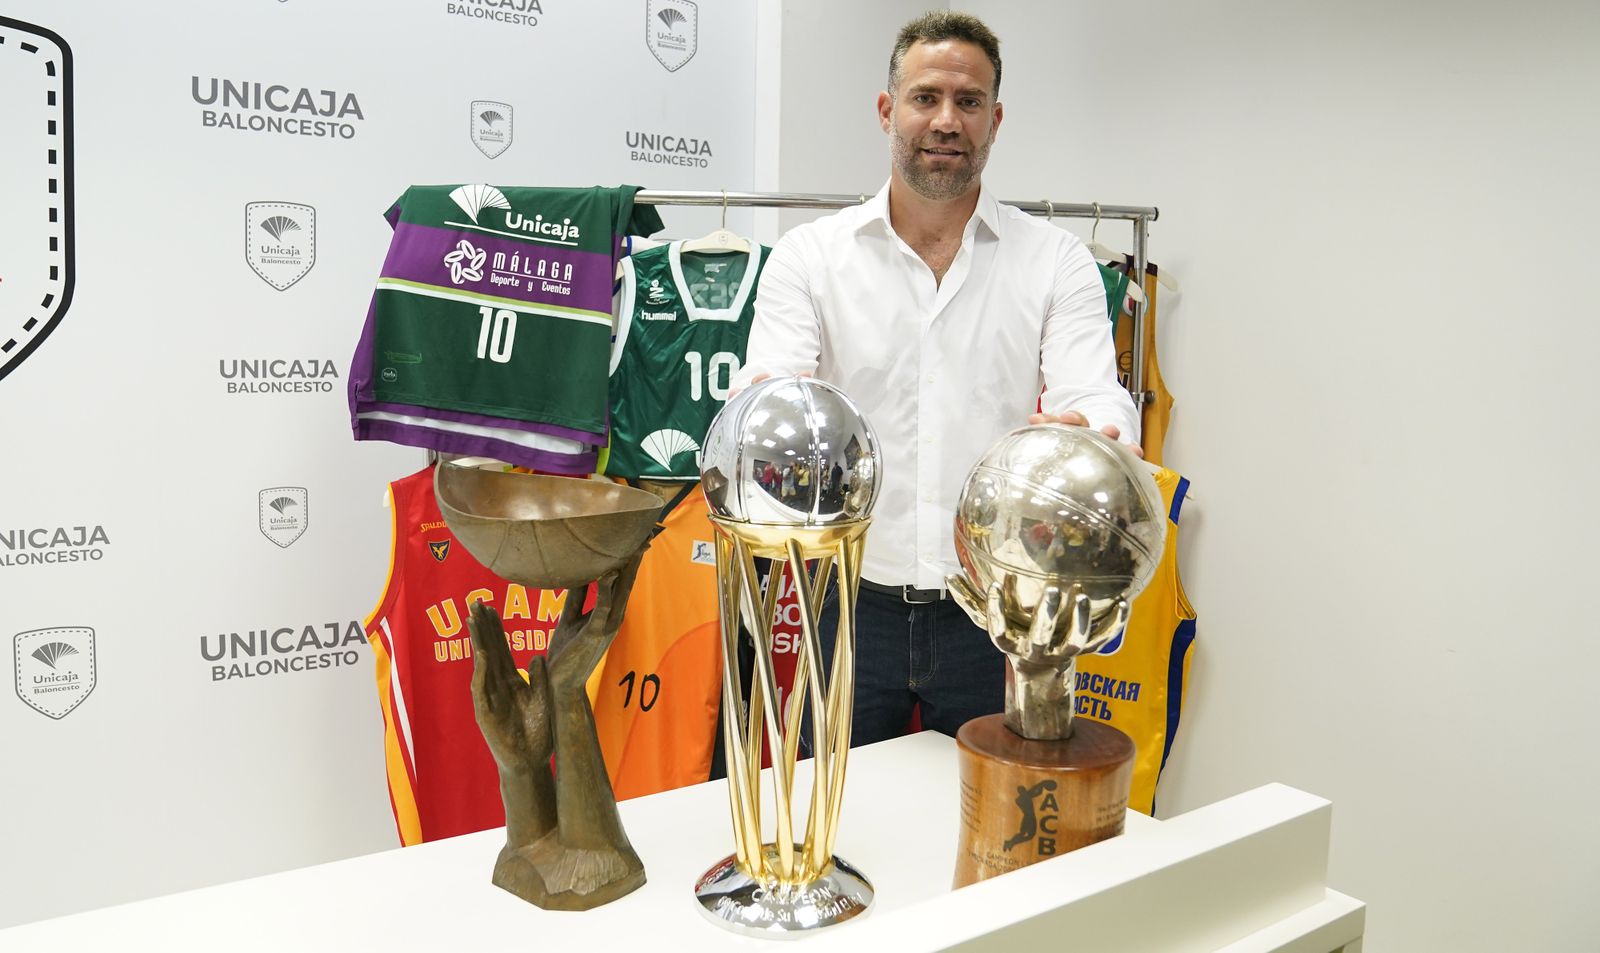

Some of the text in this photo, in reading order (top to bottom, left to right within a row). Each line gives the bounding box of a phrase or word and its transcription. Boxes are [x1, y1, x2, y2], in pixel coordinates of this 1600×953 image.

[447, 3, 538, 27] BALONCESTO
[657, 32, 686, 44] Unicaja
[192, 76, 365, 120] UNICAJA
[202, 110, 356, 140] BALONCESTO
[625, 131, 713, 157] UNICAJA
[630, 151, 709, 168] BALONCESTO
[505, 212, 580, 241] Unicaja
[261, 245, 300, 256] Unicaja
[492, 250, 573, 281] MÁLAGA
[490, 272, 571, 295] Deporte y Eventos
[641, 309, 677, 321] hummel
[476, 306, 518, 364] 10
[219, 359, 340, 379] UNICAJA
[684, 351, 741, 402] 10
[227, 381, 333, 394] BALONCESTO
[270, 516, 298, 525] Unicaja
[0, 525, 111, 550] NICAJA
[0, 549, 104, 567] LONCESTO
[200, 620, 368, 662] UNICAJA
[33, 671, 79, 684] Unicaja
[211, 650, 360, 682] BALONCESTO
[33, 685, 80, 694] Baloncesto
[618, 671, 661, 712] 10
[1038, 793, 1059, 856] ACB
